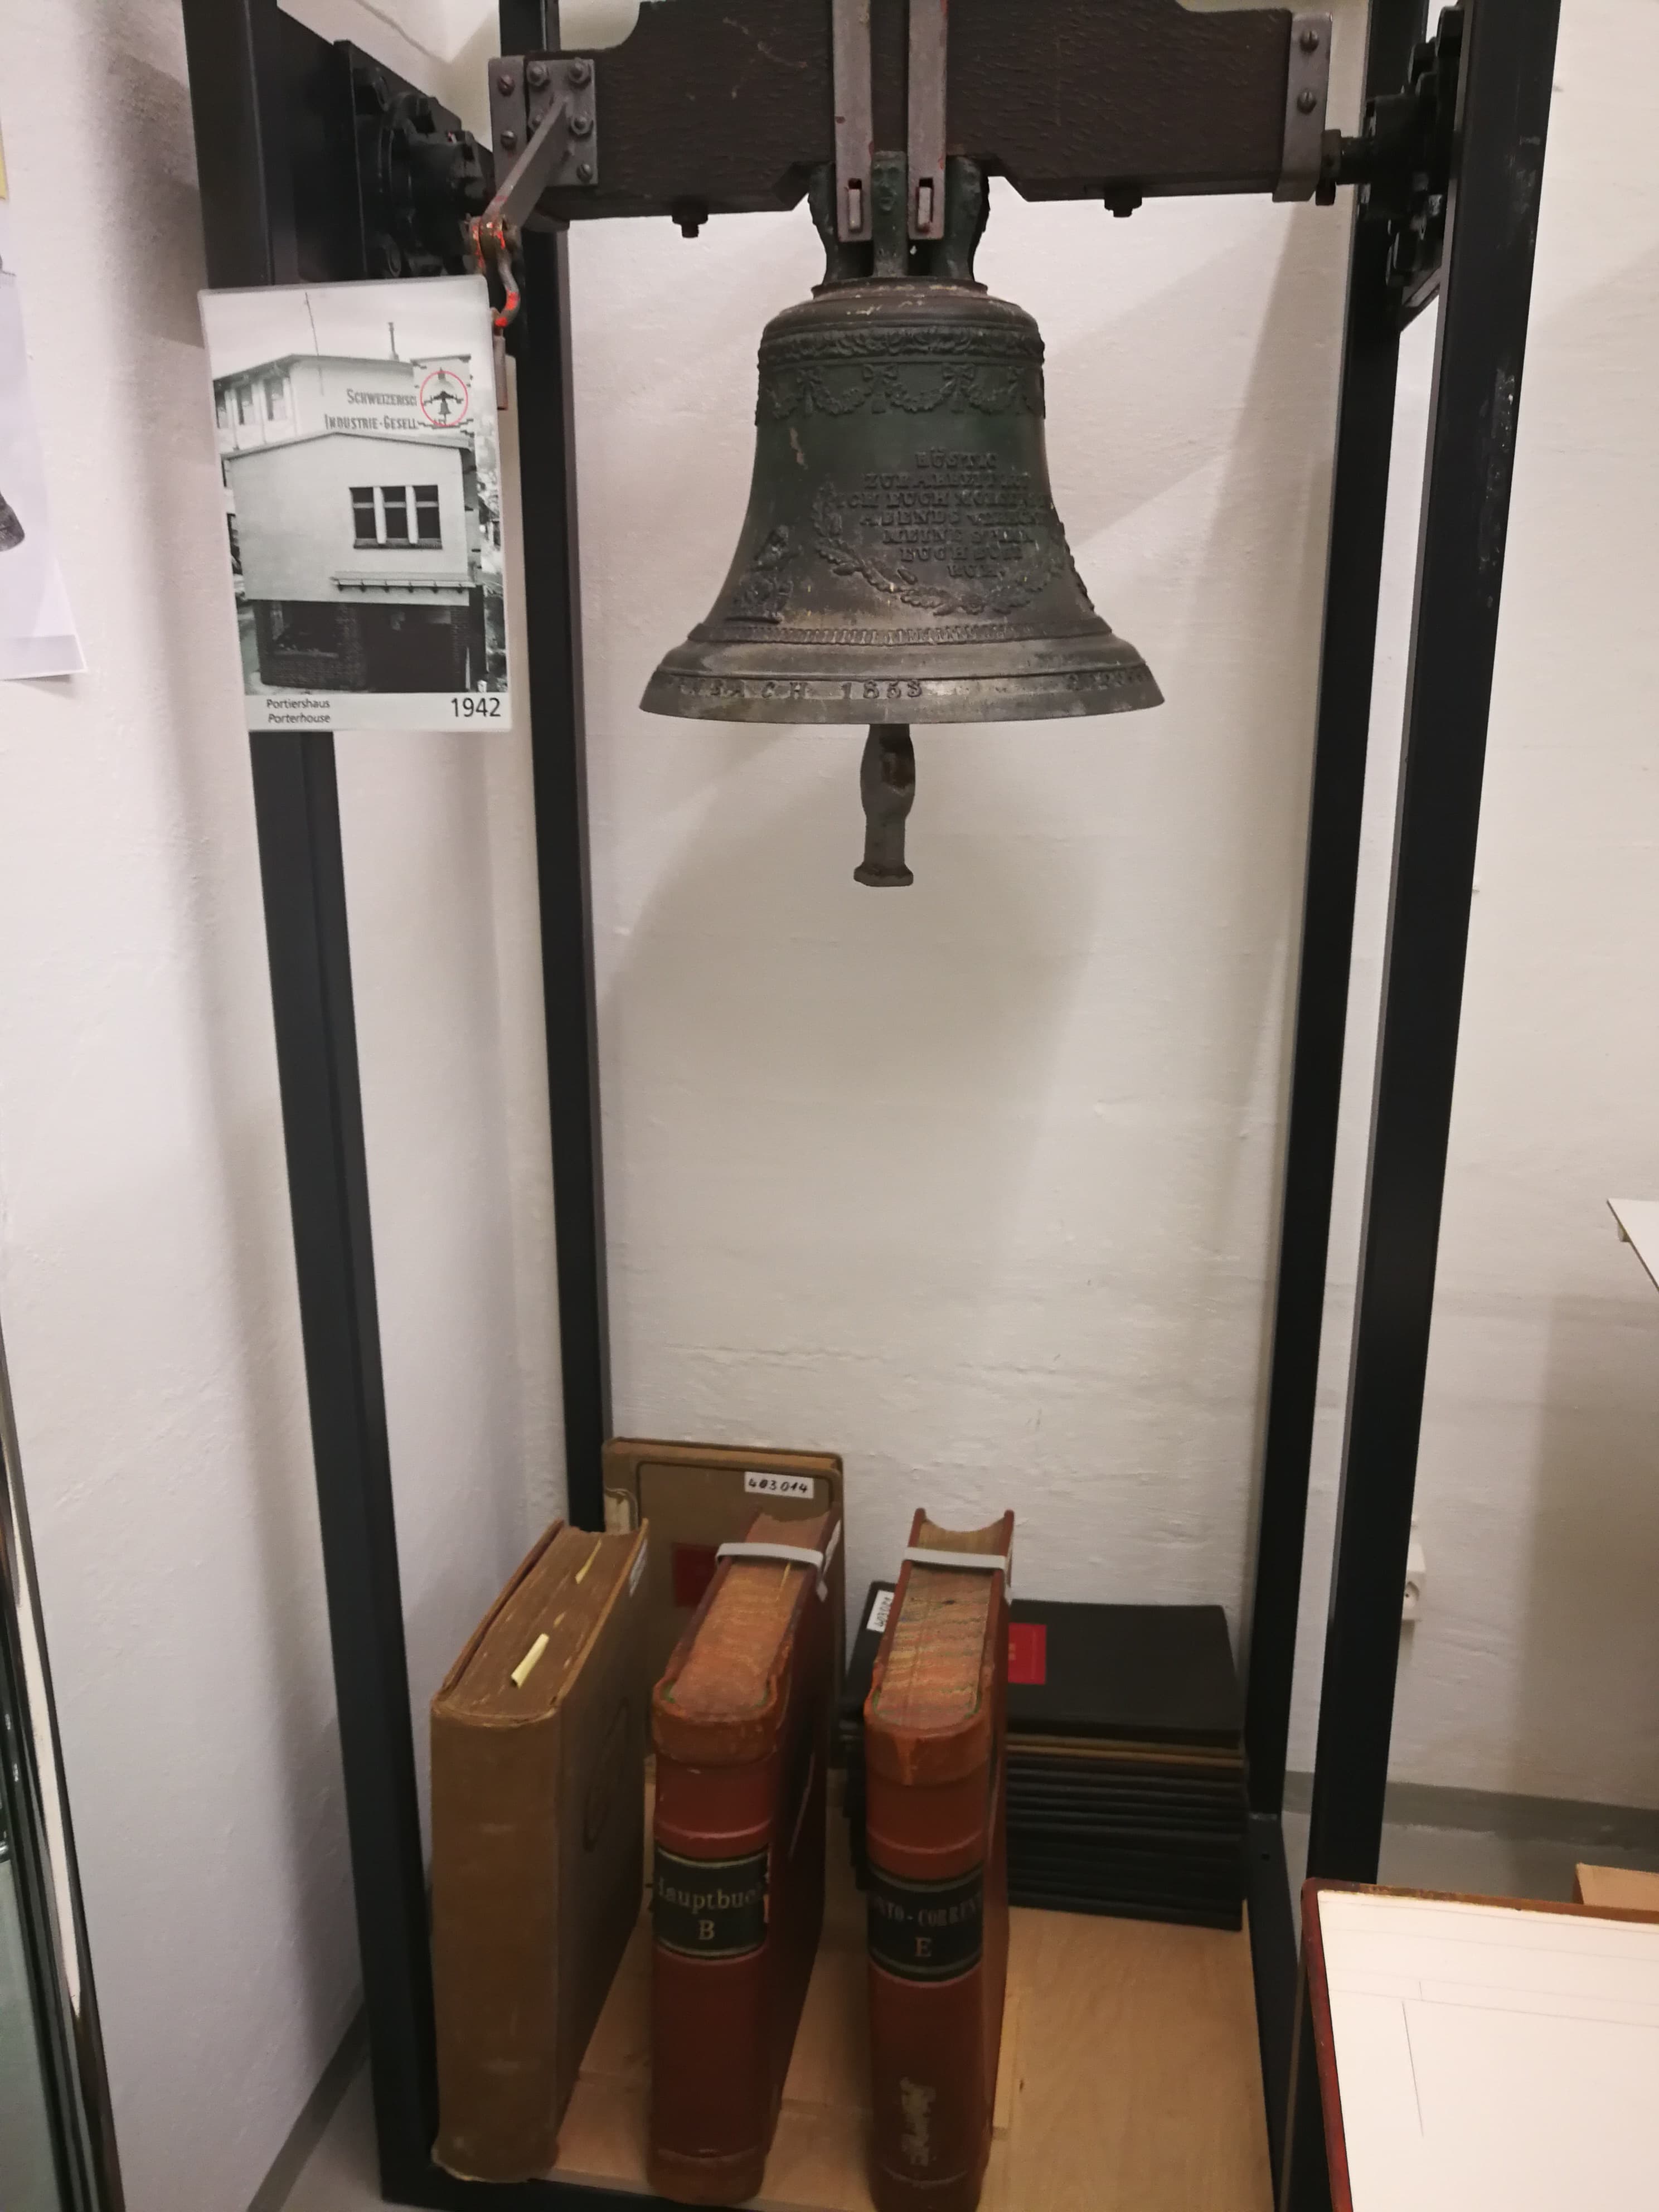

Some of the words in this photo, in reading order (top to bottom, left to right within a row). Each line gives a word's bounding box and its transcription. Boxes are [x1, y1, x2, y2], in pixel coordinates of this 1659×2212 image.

[266, 698, 331, 710] Portiershaus
[450, 697, 501, 718] 1942
[268, 711, 331, 724] Porterhouse
[748, 1477, 808, 1493] 403014
[658, 1875, 763, 1915] auptbuc
[697, 1918, 716, 1941] B
[914, 1936, 933, 1958] E
